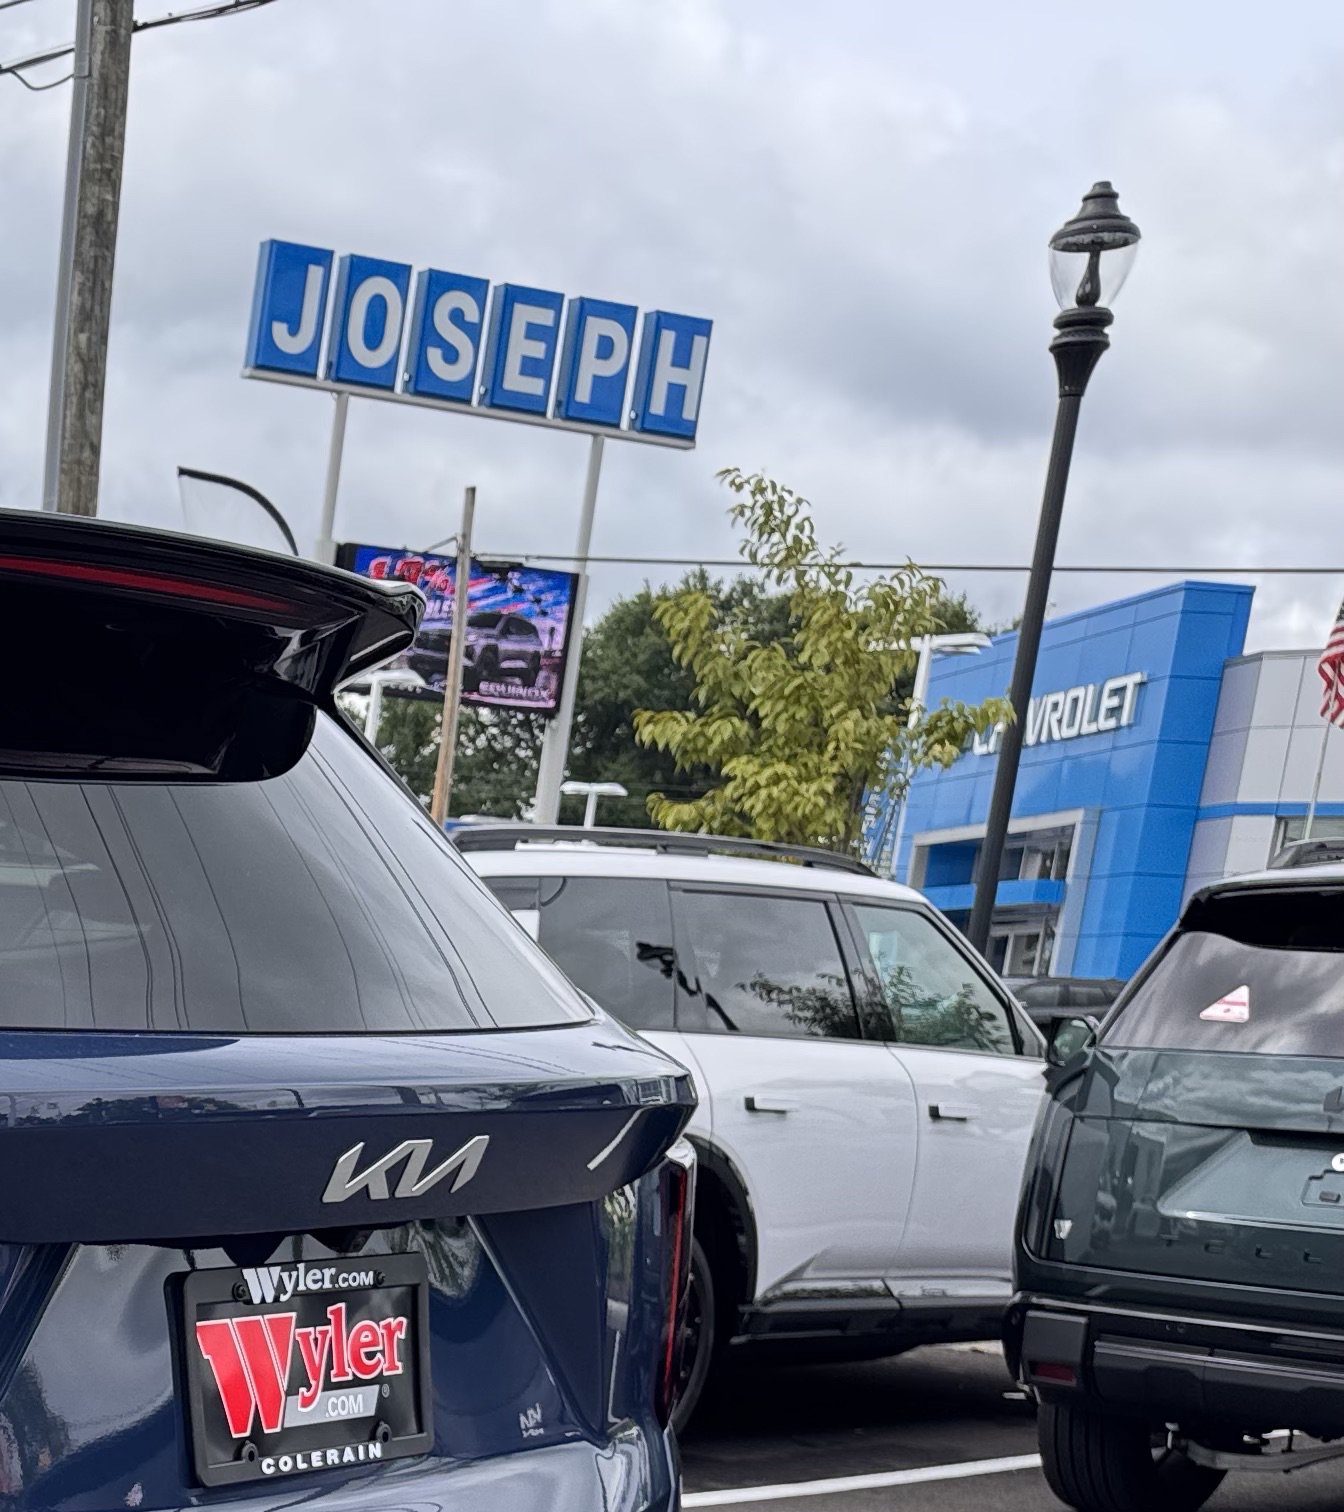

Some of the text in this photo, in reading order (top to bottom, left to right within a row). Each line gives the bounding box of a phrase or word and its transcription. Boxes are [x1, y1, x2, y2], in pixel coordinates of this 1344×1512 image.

[271, 263, 708, 421] JOSEPH
[195, 1302, 408, 1439] Wyler
[261, 1442, 383, 1476] COLERAIN
